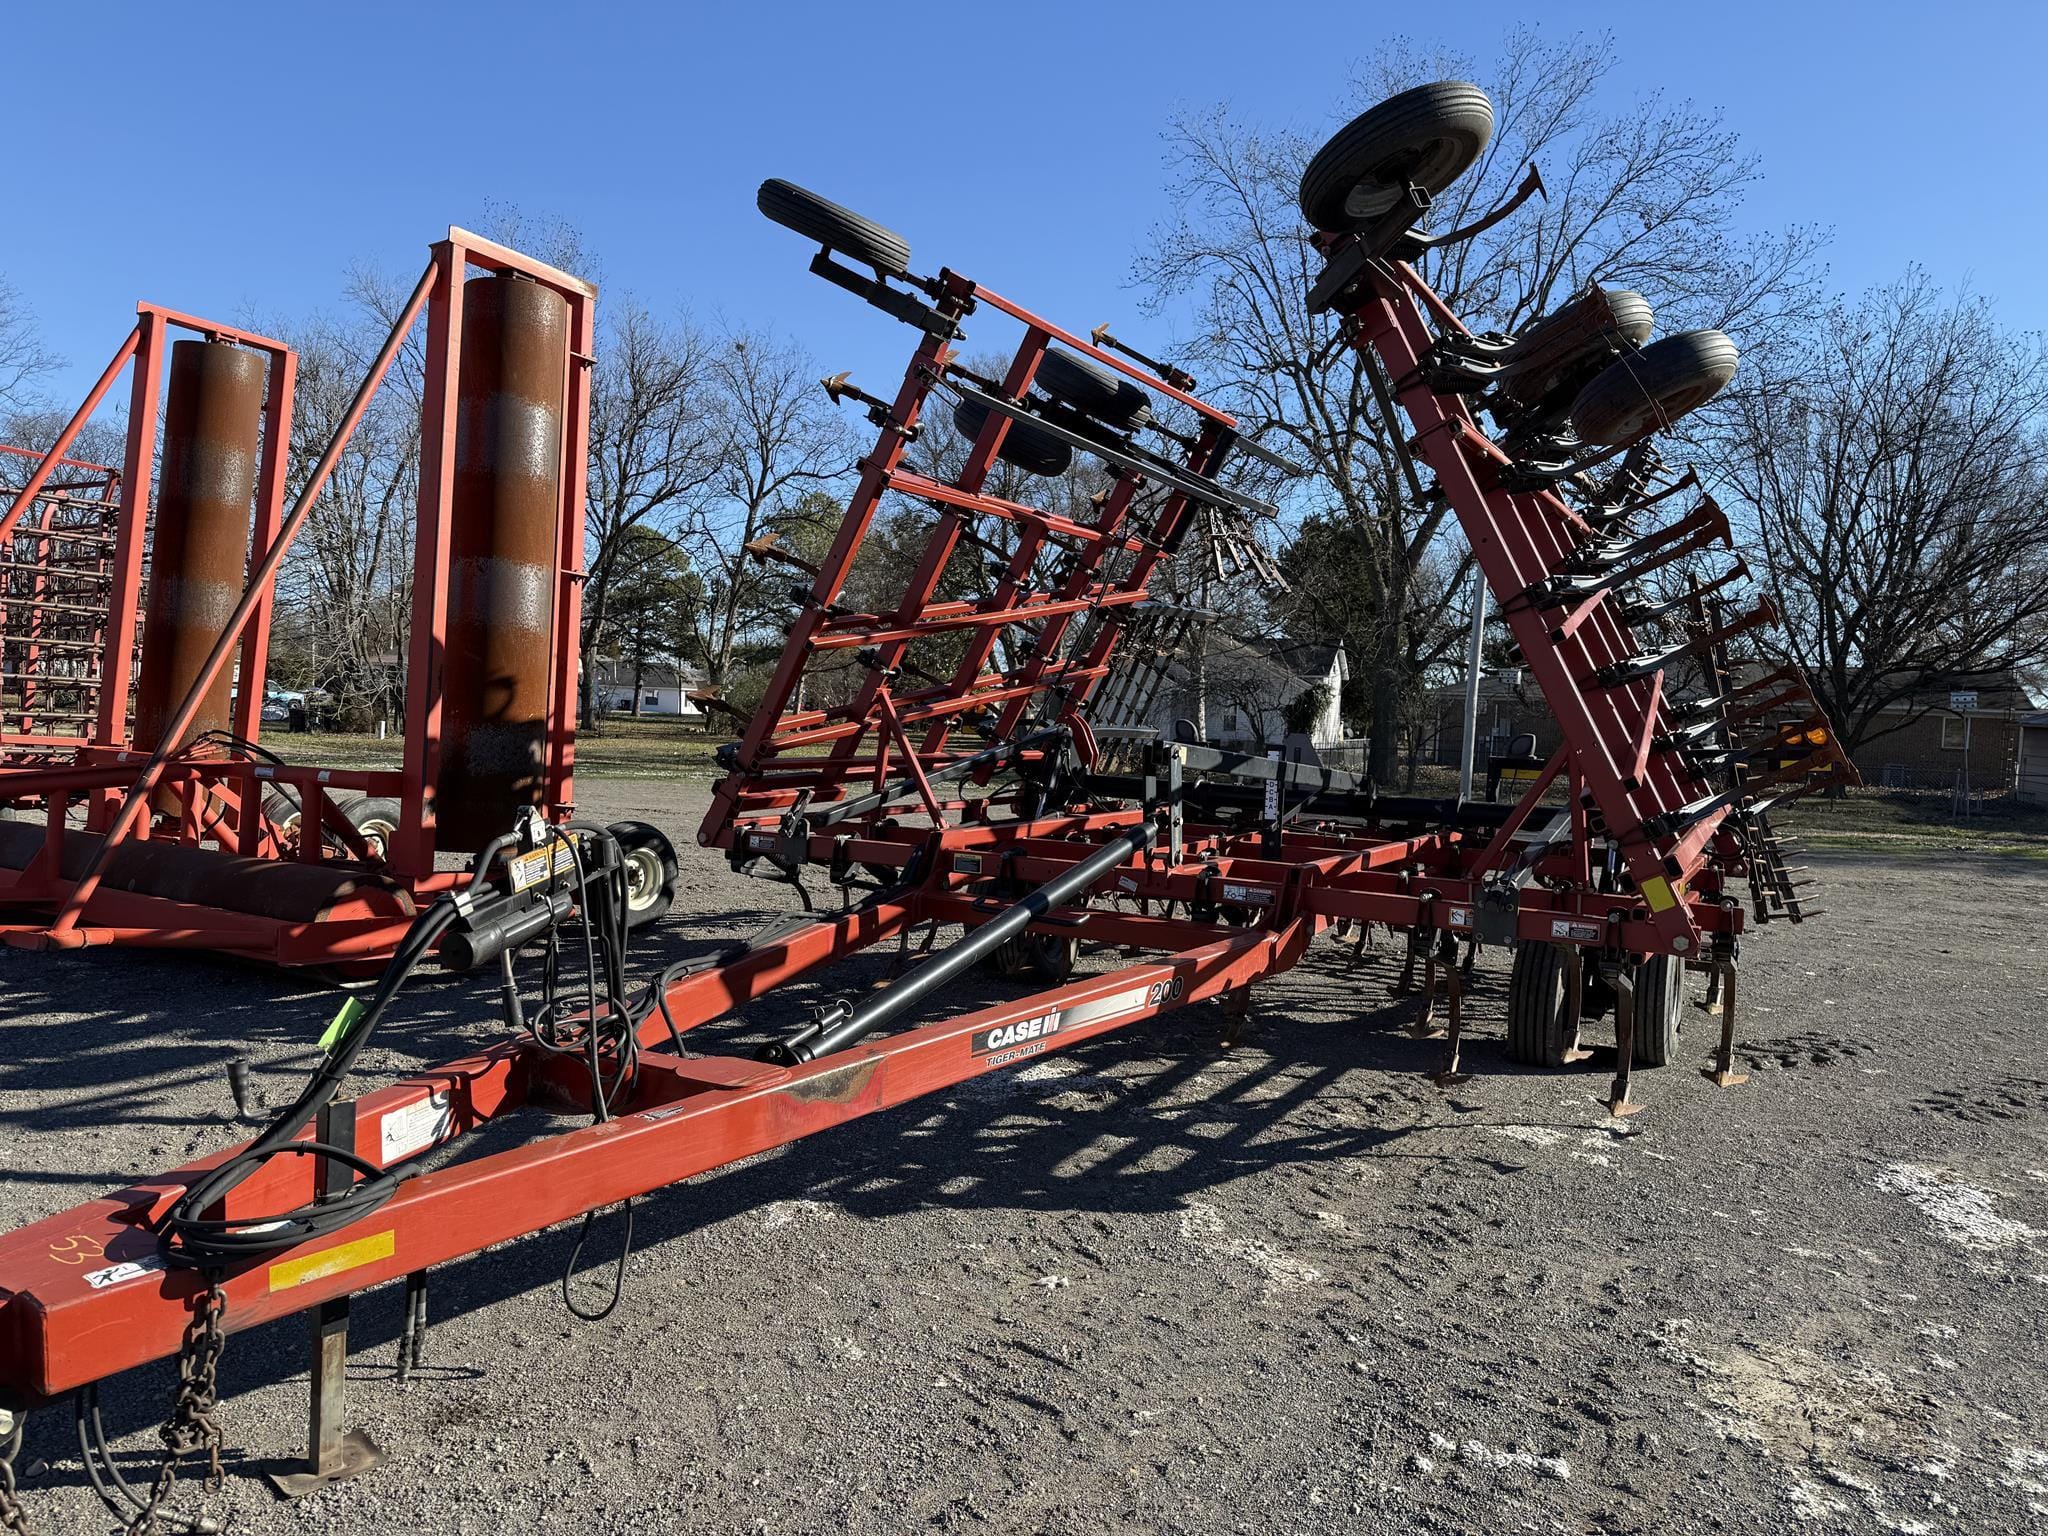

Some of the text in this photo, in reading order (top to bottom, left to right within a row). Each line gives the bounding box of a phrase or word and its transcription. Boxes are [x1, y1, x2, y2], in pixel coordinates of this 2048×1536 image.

[1148, 976, 1184, 1008] 200
[987, 1017, 1043, 1049] CASE
[985, 1041, 1047, 1067] TIGER-MATE
[49, 1235, 105, 1265] 53
